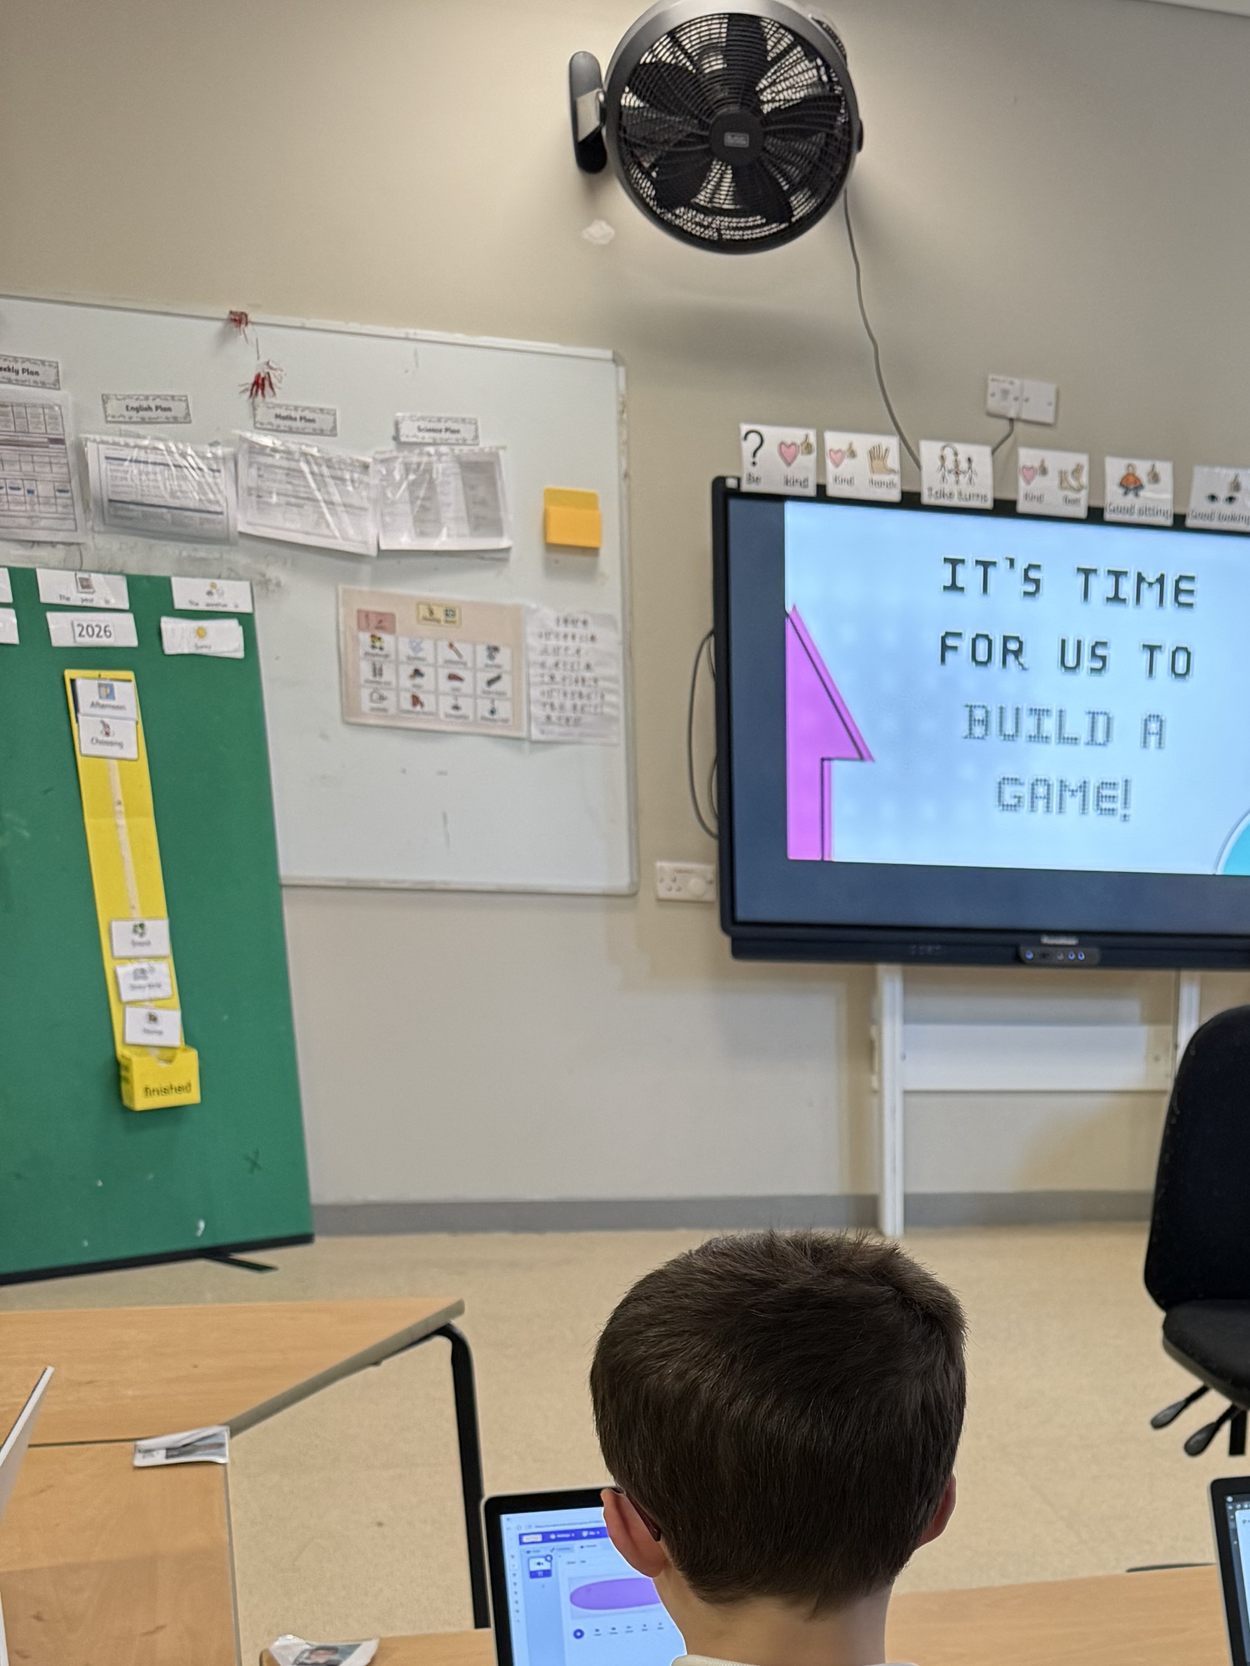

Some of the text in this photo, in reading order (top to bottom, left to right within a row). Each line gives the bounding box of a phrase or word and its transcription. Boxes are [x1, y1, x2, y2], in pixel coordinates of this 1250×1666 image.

[0, 365, 40, 377] eekly Plan
[125, 404, 172, 414] English Plan
[943, 557, 1196, 609] IT'S TIME
[77, 623, 112, 639] 2026
[940, 630, 1192, 680] FOR US TO
[962, 703, 1166, 749] BUILD A
[995, 776, 1131, 822] GAME!
[144, 1082, 192, 1098] finished
